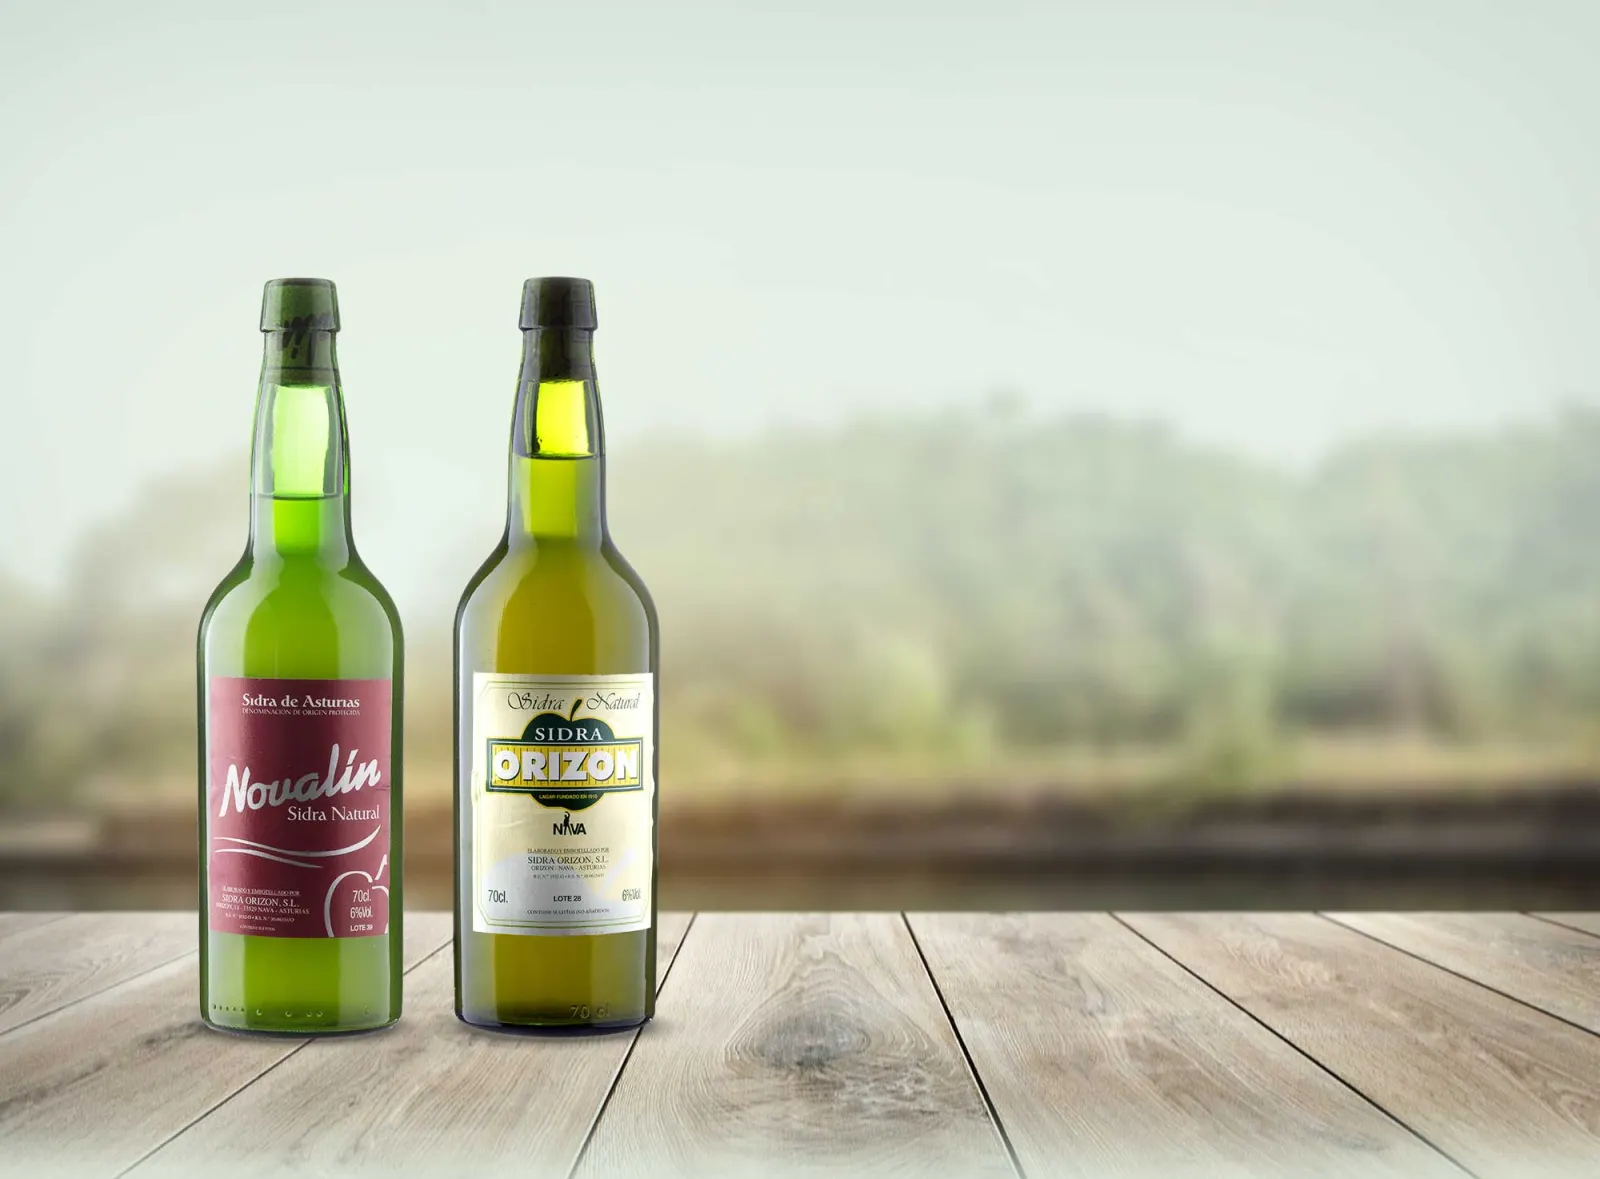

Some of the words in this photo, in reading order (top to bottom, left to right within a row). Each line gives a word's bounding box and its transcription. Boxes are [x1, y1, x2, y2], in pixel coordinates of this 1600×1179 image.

[242, 693, 277, 707] Sidra
[281, 695, 299, 707] de
[302, 695, 360, 708] Asturias
[508, 691, 565, 710] Sidra
[586, 691, 641, 710] Natural
[535, 727, 604, 741] SIDRA
[494, 750, 639, 782] ORIZON
[219, 743, 382, 818] Novalín
[287, 806, 327, 821] Sidra
[331, 805, 380, 821] Natural
[528, 856, 555, 865] SIDRA
[557, 856, 594, 865] ORIZON,
[222, 893, 244, 904] SIDRA
[488, 889, 508, 903] 70cl.
[350, 924, 366, 932] LOTE
[570, 1005, 590, 1018] 70
